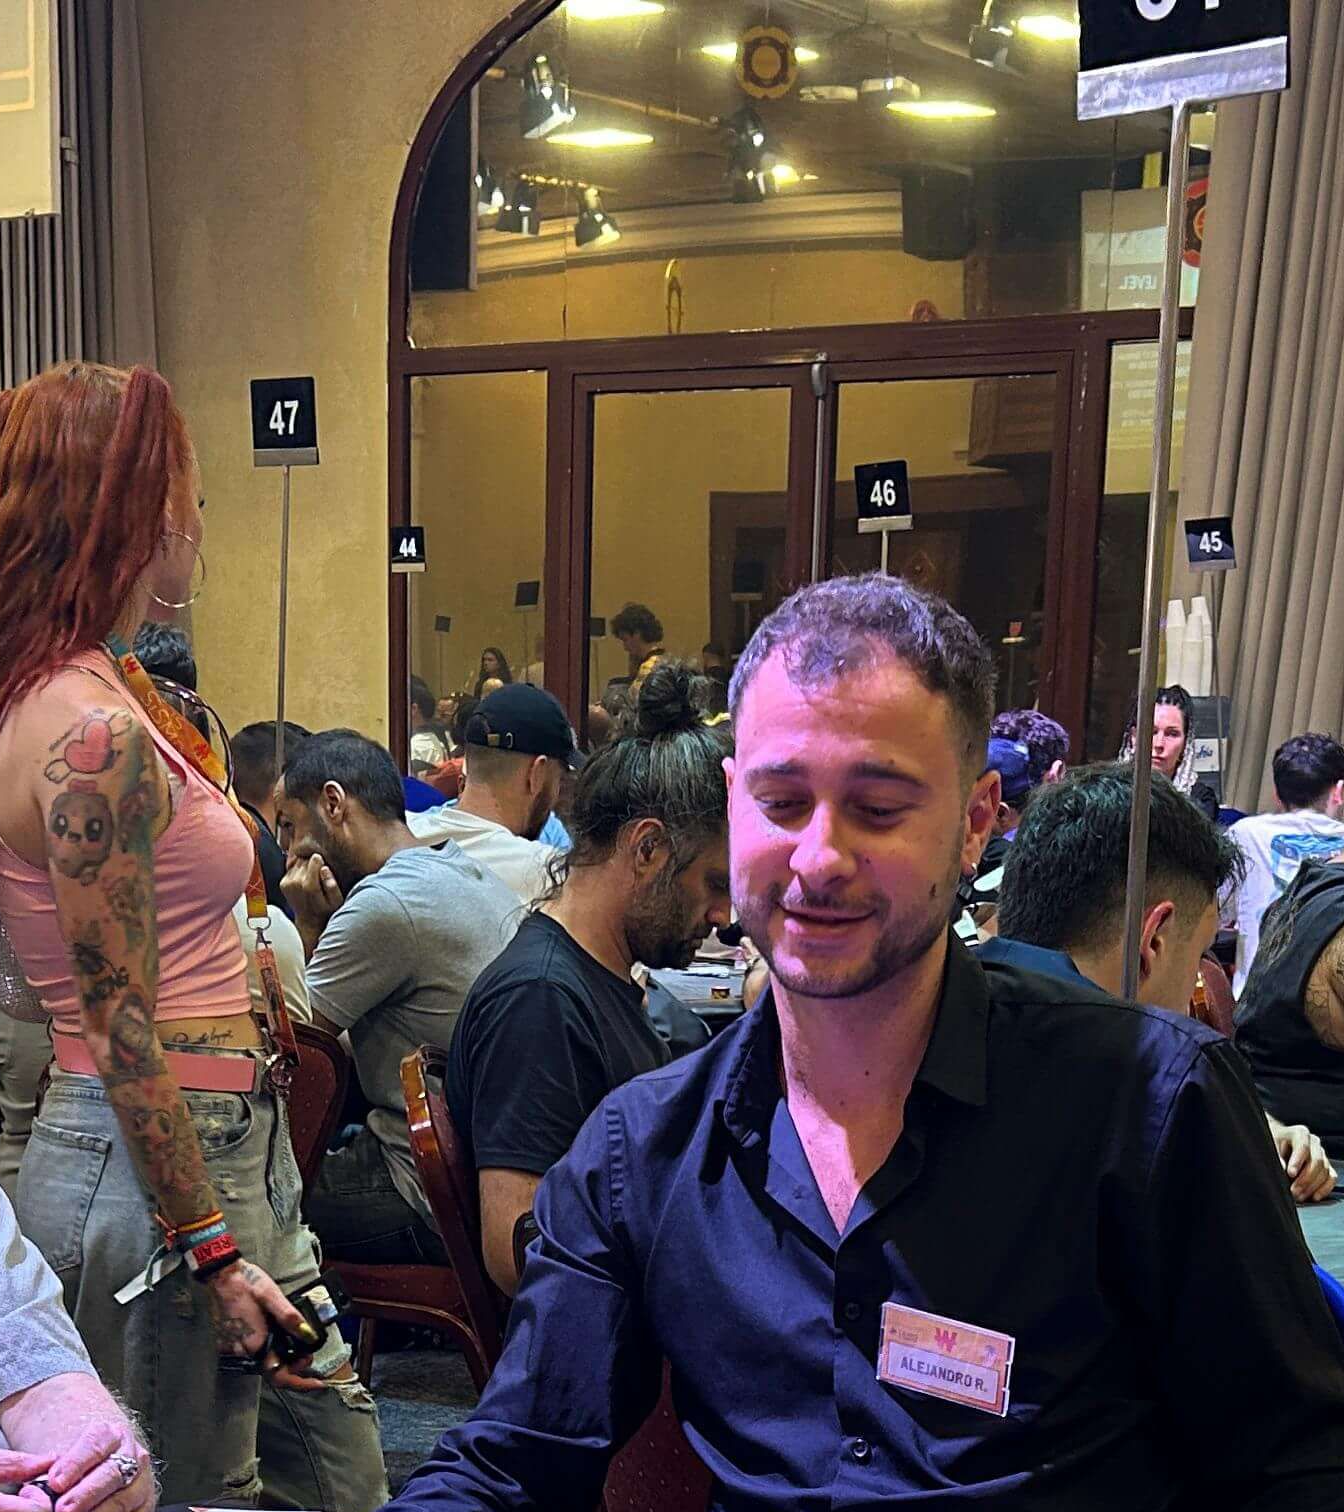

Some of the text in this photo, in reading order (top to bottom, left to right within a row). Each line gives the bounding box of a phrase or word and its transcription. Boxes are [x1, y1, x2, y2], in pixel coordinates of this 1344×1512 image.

[269, 399, 299, 436] 47
[870, 479, 896, 507] 46
[399, 536, 417, 557] 44
[1199, 530, 1224, 553] 45
[900, 1356, 973, 1388] ALEJANDRO
